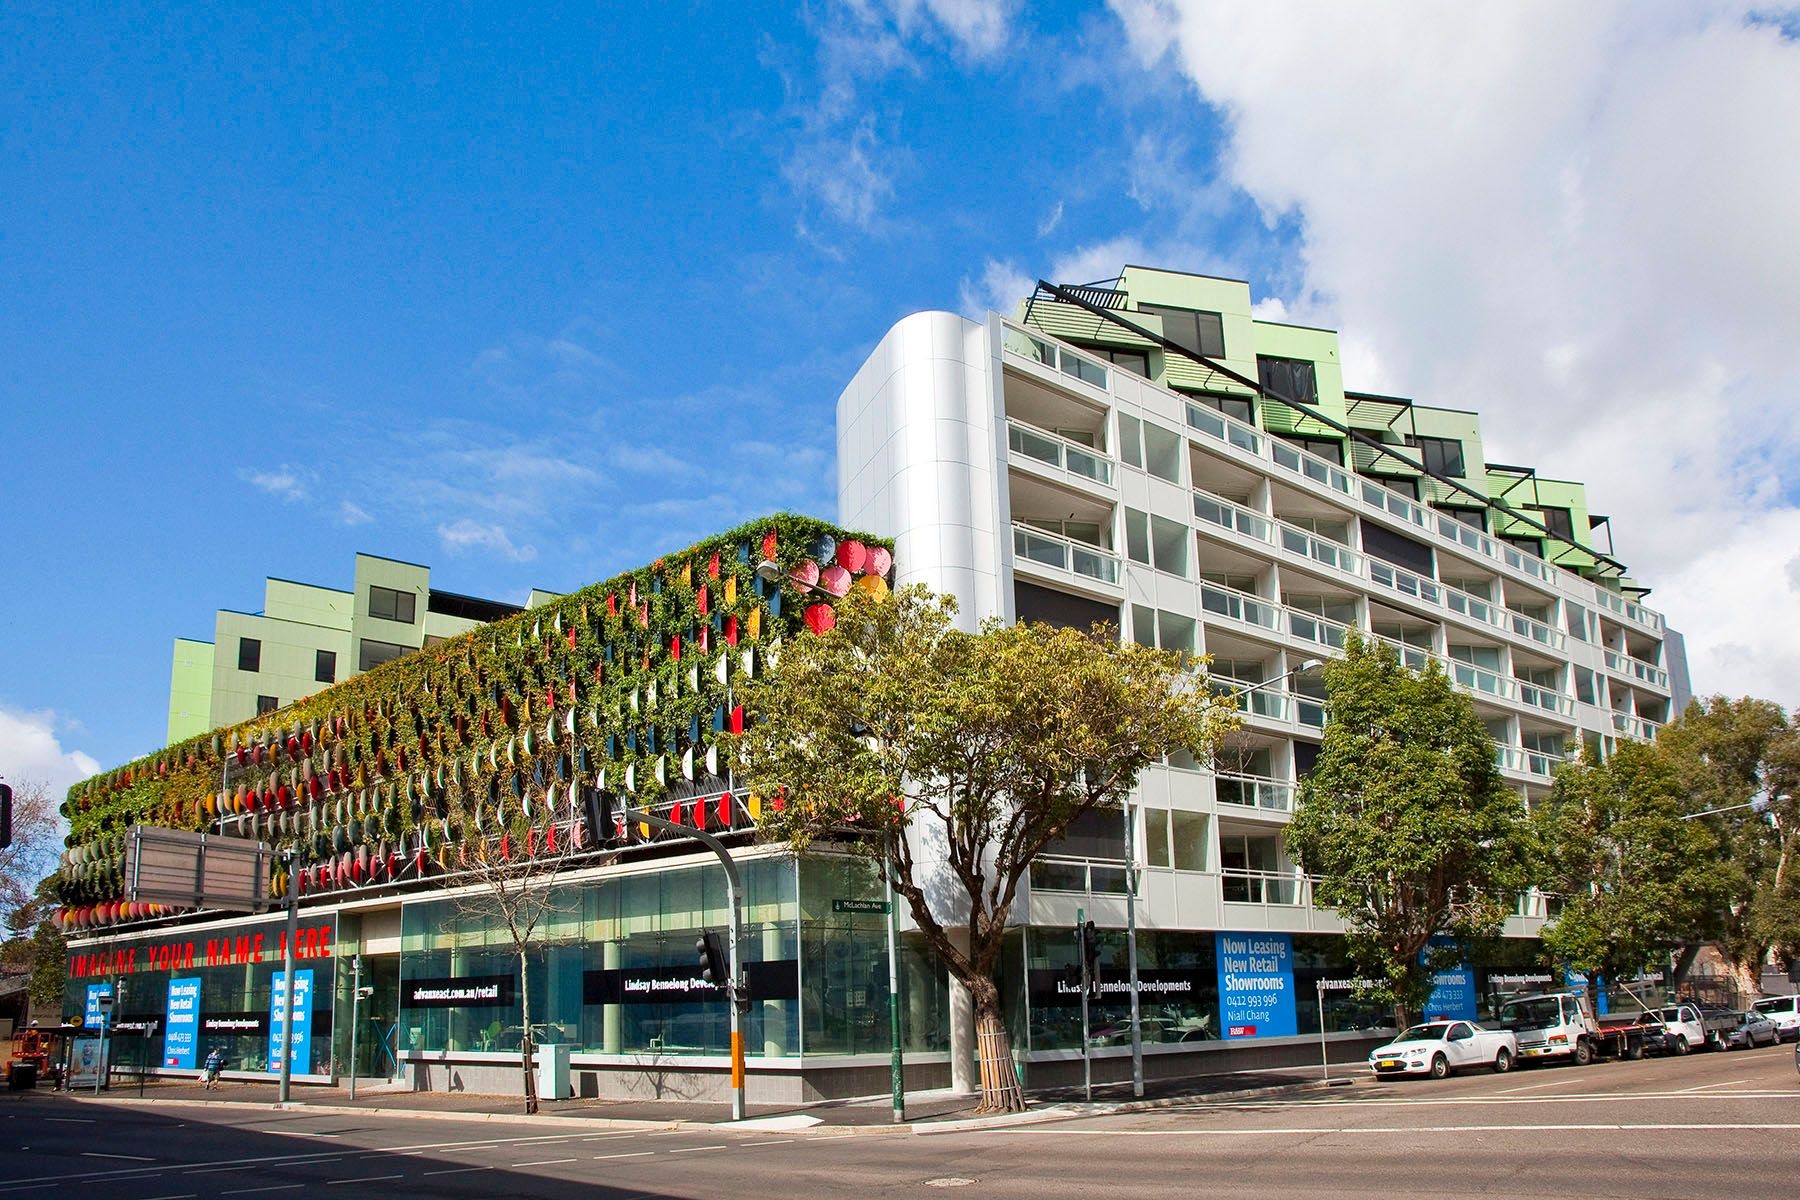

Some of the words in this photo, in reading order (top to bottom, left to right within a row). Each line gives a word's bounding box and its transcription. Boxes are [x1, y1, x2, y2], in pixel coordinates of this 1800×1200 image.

[843, 901, 870, 909] McLachlan
[871, 902, 882, 910] Ave
[70, 948, 136, 977] IMAGINE
[149, 942, 194, 971] YOUR
[207, 933, 264, 967] NAME
[1223, 938, 1246, 954] Now
[1248, 938, 1286, 959] Leasing
[1224, 956, 1247, 973] New
[1249, 956, 1278, 973] Retail
[624, 978, 651, 993] Lindsay
[651, 977, 689, 992] Bennelong
[1138, 979, 1191, 994] Developments
[1225, 973, 1284, 991] Showrooms
[413, 984, 498, 1000] advanxeast.com.au/retail
[1227, 995, 1246, 1007] 0412
[1248, 995, 1262, 1007] 993
[1264, 993, 1278, 1007] 996
[1228, 1010, 1245, 1021] Niall
[1246, 1010, 1270, 1022] Chang
